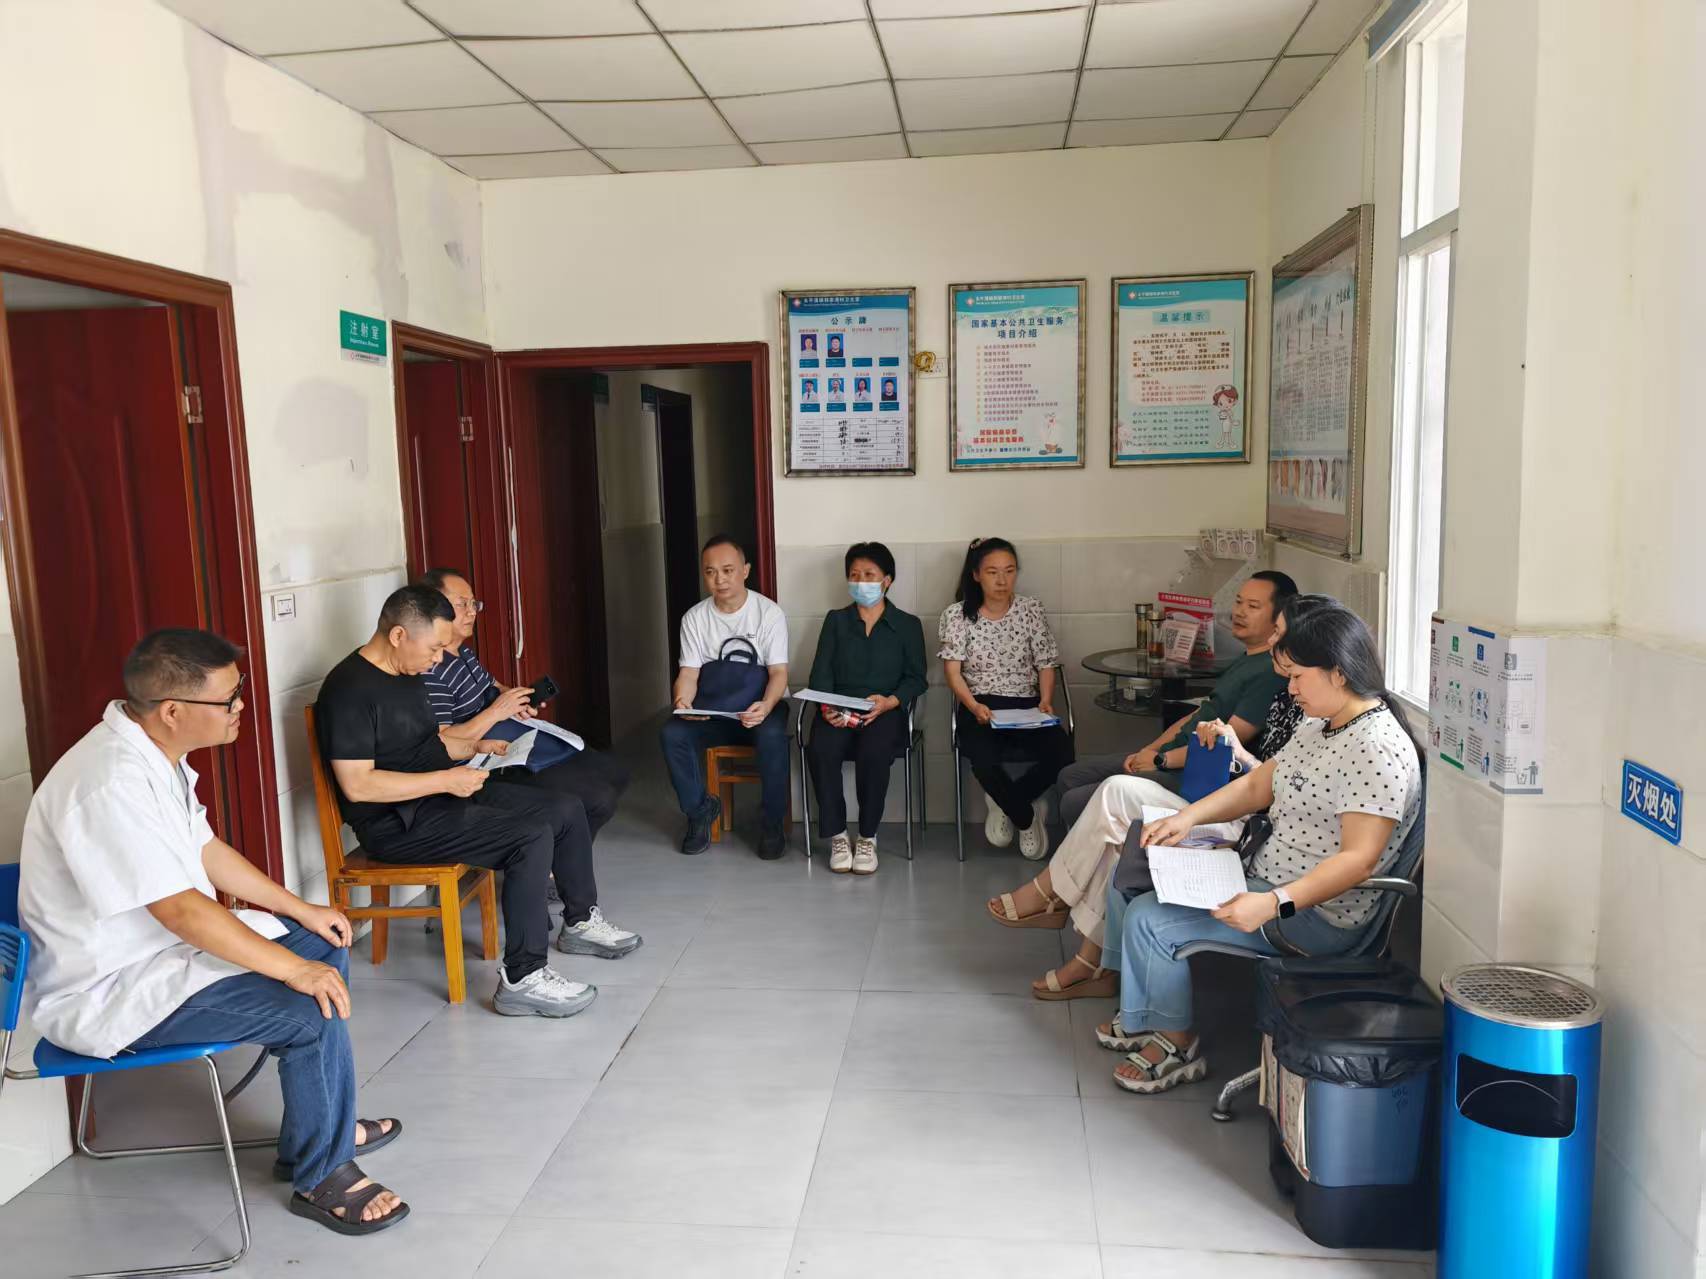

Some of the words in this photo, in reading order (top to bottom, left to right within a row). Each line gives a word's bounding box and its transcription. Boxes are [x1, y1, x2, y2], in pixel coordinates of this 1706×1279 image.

[830, 316, 868, 326] 公示牌
[971, 316, 1064, 328] 国家基本公共卫生服务
[997, 328, 1038, 339] 项目介绍
[1627, 773, 1677, 829] 灭烟处
